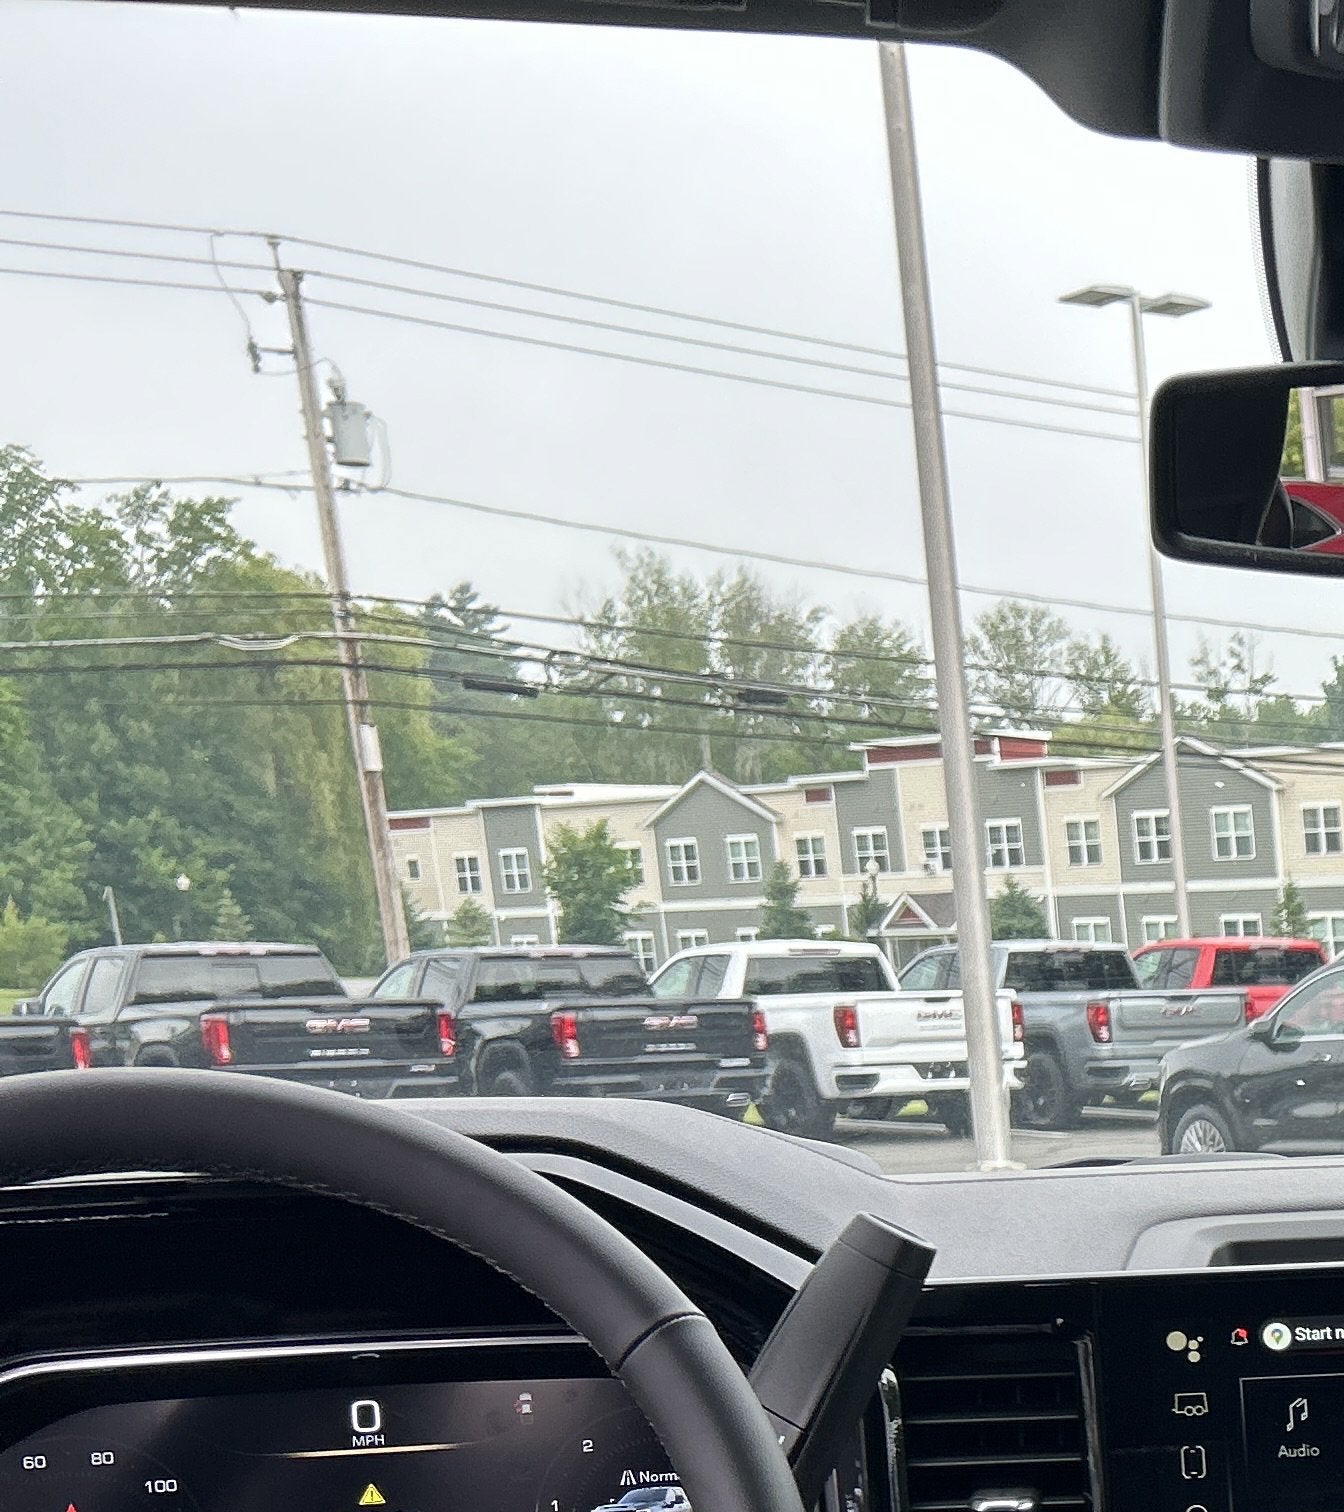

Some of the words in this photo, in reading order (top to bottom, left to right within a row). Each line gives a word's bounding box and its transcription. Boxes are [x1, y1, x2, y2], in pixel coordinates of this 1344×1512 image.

[1295, 1326, 1332, 1341] Start
[351, 1400, 381, 1433] 0
[352, 1434, 385, 1447] MPH
[582, 1439, 594, 1453] 2
[1278, 1443, 1320, 1458] Audio
[22, 1455, 47, 1469] 60
[91, 1451, 115, 1466] 80
[639, 1471, 681, 1483] Norm
[144, 1479, 178, 1493] 100
[551, 1500, 559, 1512] 1
